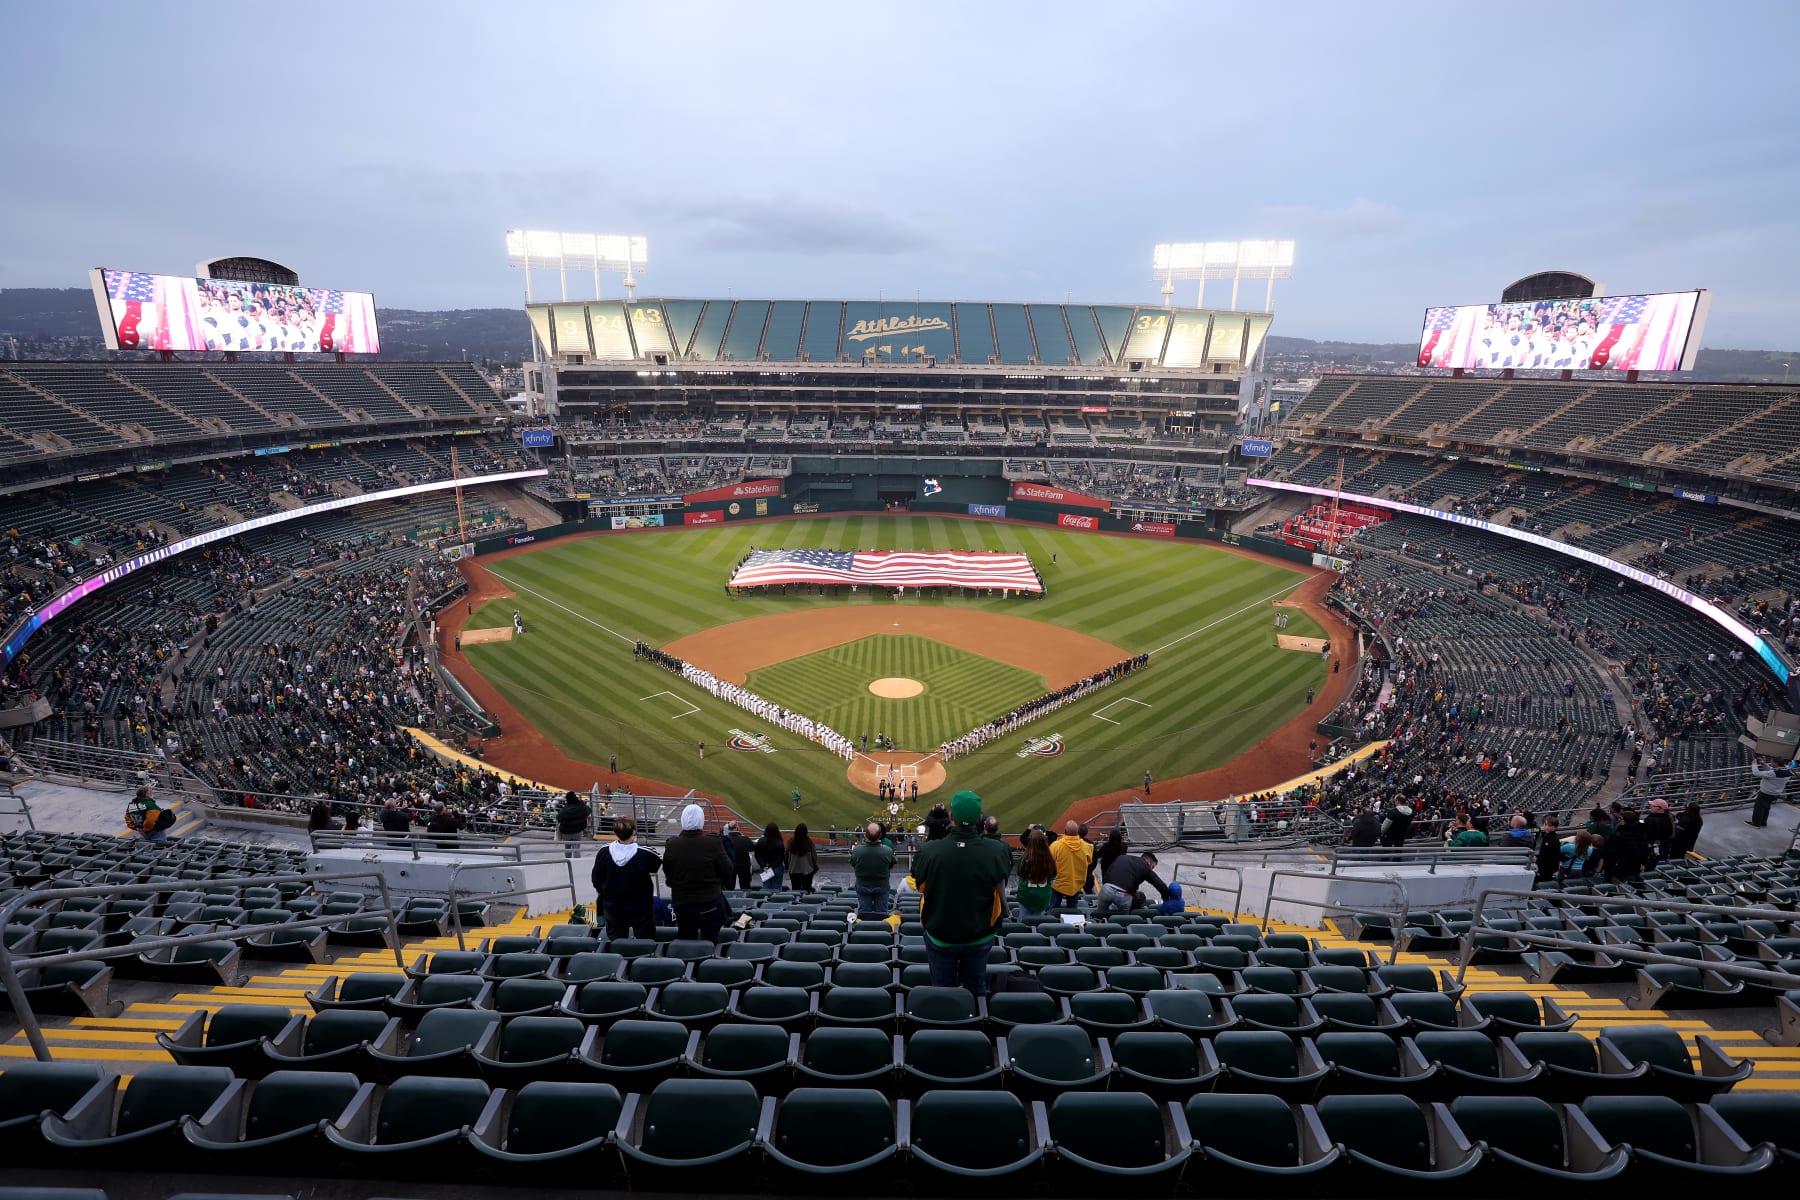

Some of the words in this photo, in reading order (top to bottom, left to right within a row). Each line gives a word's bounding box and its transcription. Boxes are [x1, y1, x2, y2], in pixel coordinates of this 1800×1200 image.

[633, 308, 662, 323] 43
[563, 320, 577, 334] 9
[594, 315, 622, 329] 24
[847, 315, 948, 341] Athletics
[1137, 315, 1167, 330] 34
[525, 435, 550, 445] xfinity
[1244, 443, 1270, 454] xfinity
[1027, 488, 1045, 498] State
[1045, 490, 1064, 500] Farm
[974, 505, 1000, 516] xfinity
[514, 535, 535, 544] Fanatics
[126, 560, 136, 572] SO
[1646, 987, 1653, 996] 11
[1788, 1016, 1796, 1025] 2
